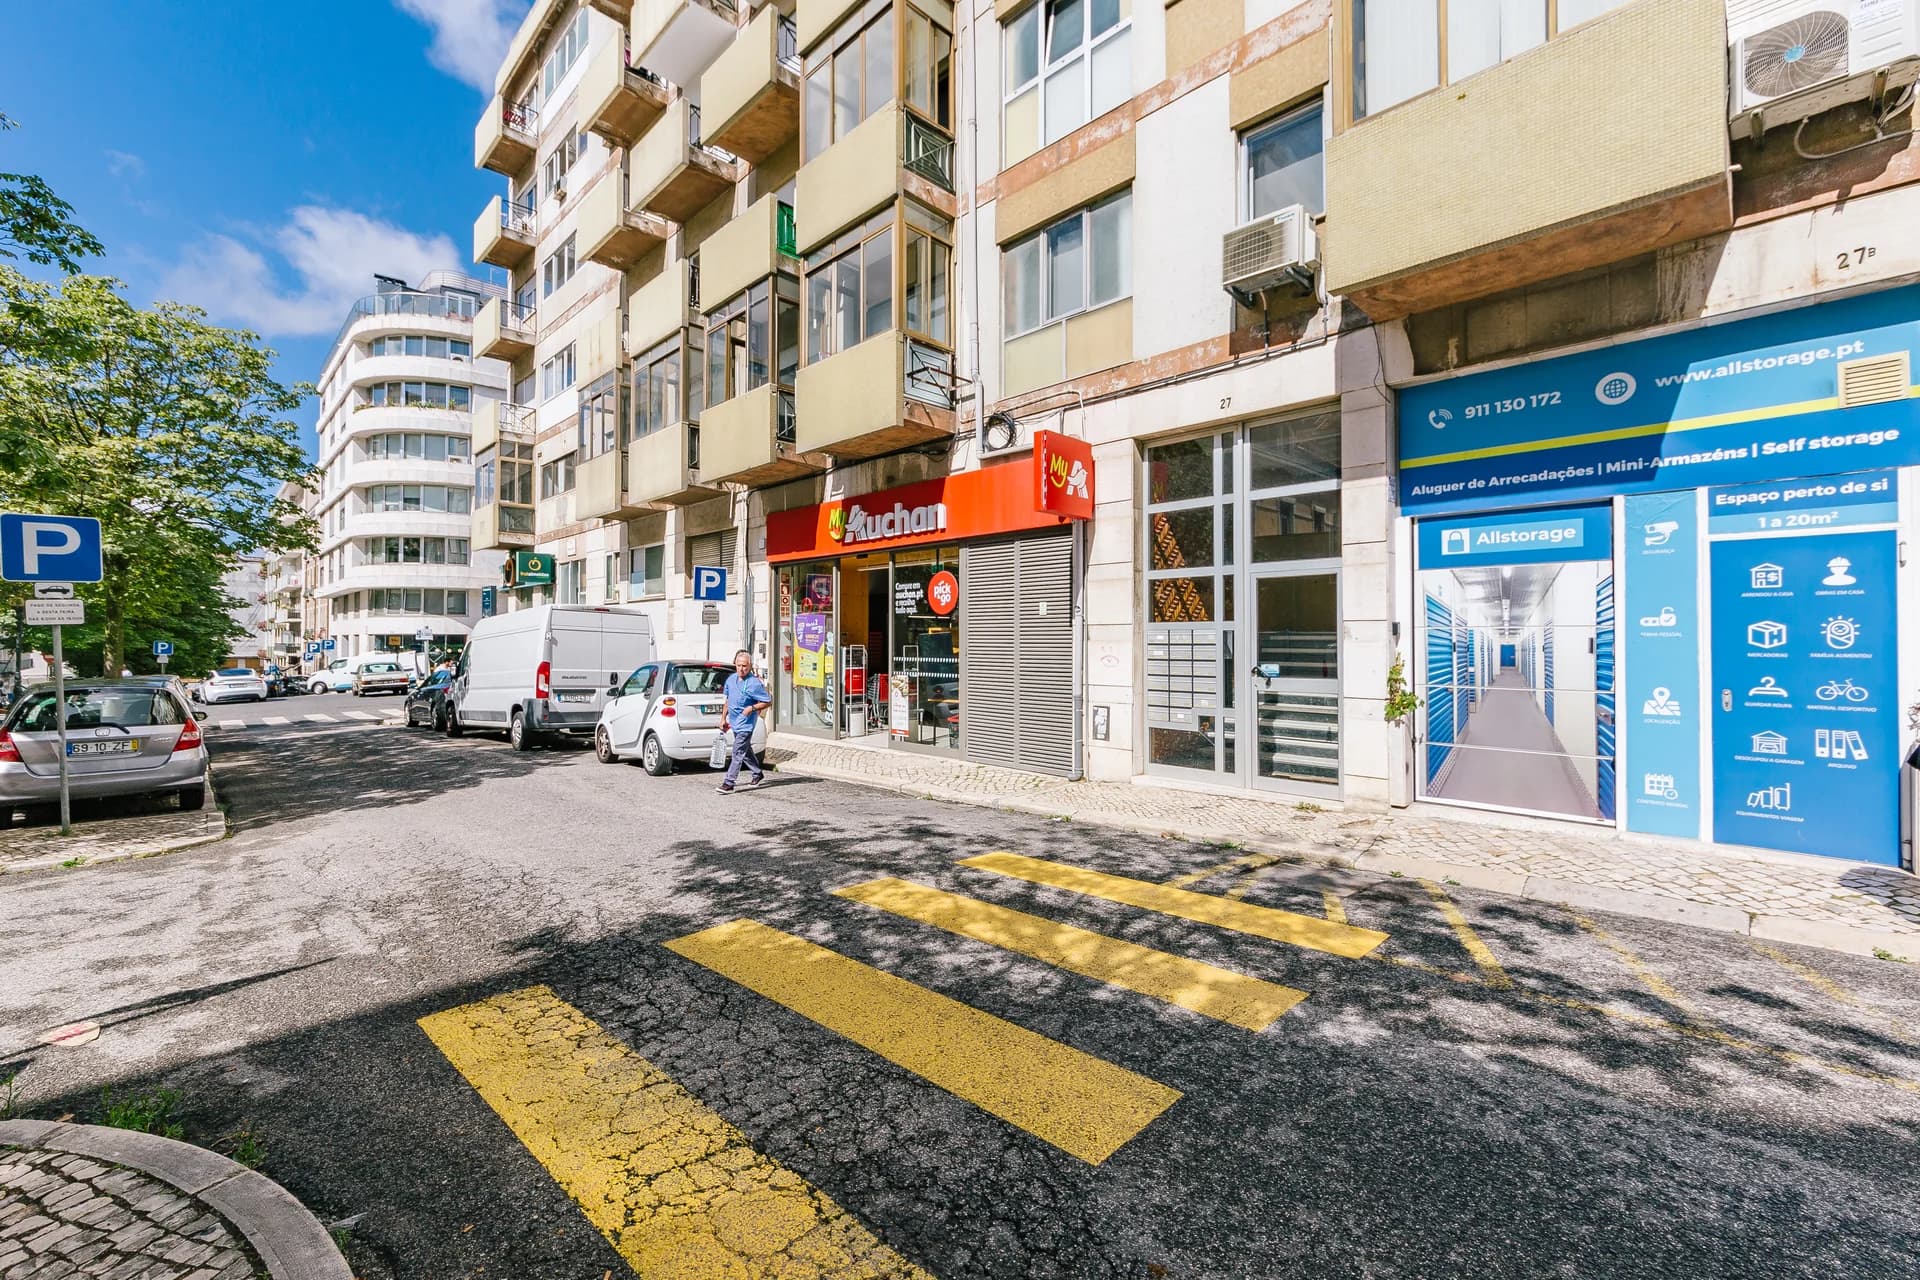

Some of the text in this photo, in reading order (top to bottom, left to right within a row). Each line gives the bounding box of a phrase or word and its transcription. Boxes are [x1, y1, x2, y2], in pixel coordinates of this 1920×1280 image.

[1655, 339, 1864, 387] www.allstorage.pt
[1220, 397, 1231, 409] 27
[1465, 391, 1561, 419] 911 130 172
[1050, 453, 1068, 488] My
[1411, 480, 1465, 495] Aluguer
[1468, 479, 1485, 489] de
[1488, 466, 1594, 487] Arrecadações
[1606, 446, 1748, 473] Mini-Armazéns
[1761, 438, 1806, 455] Self
[1808, 429, 1900, 451] storage
[1715, 478, 1888, 506] Espaço perto de si
[844, 503, 947, 543] Auchan
[1758, 516, 1766, 529] 1
[1770, 518, 1781, 528] a
[1476, 525, 1576, 545] Allstorage
[22, 522, 81, 574] P
[700, 570, 720, 597] P
[895, 589, 924, 600] auchan.pt
[934, 582, 951, 598] pick
[940, 594, 951, 606] go
[158, 643, 169, 653] P
[310, 643, 318, 652] P
